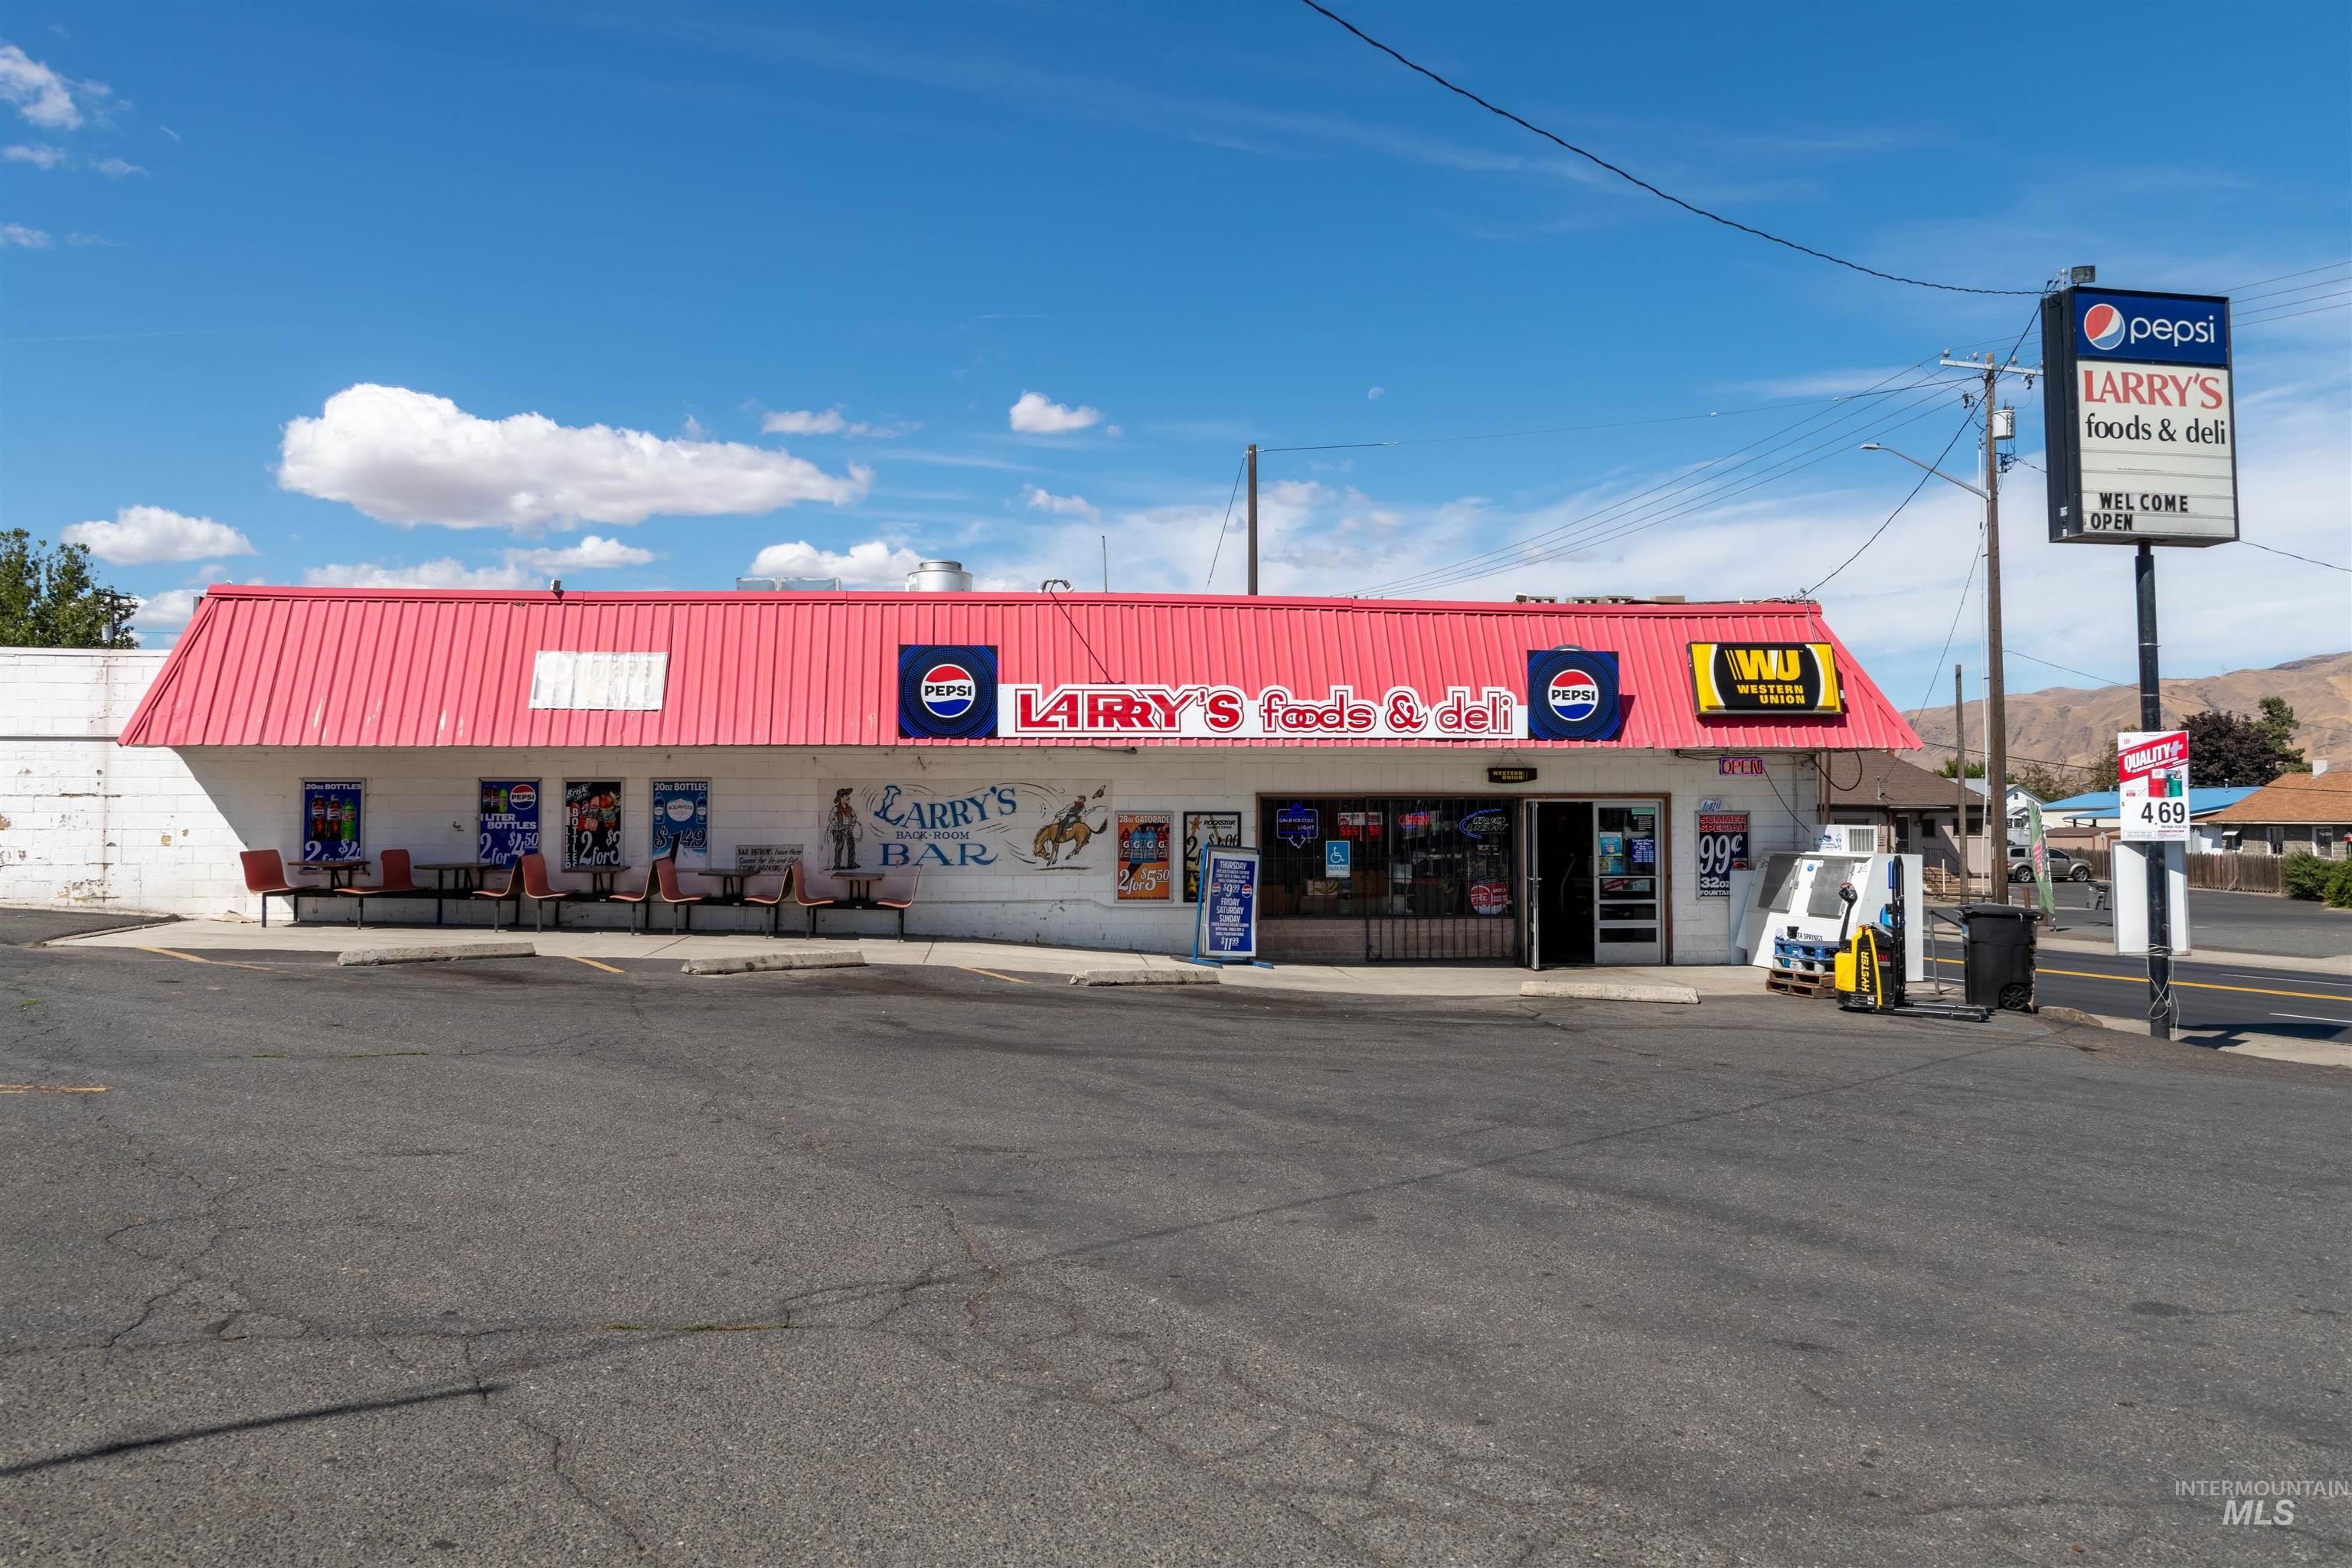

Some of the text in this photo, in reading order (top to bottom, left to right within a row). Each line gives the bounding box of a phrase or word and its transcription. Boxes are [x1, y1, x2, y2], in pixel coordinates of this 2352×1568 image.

[2131, 315, 2215, 347] pepsi
[2083, 370, 2223, 410] LARRY'S
[2086, 413, 2226, 445] foods & deli
[2091, 513, 2133, 531] OPEN
[1725, 649, 1801, 681] WU
[924, 684, 972, 697] PEPSI
[1551, 689, 1596, 701] PEPSI
[1736, 684, 1804, 694] WESTERN
[1759, 694, 1805, 704] UNION
[1015, 688, 1514, 734] LARRY'S foods & deli
[1723, 759, 1762, 774] OPEN
[874, 785, 1017, 829] LARRY'S
[2141, 802, 2185, 825] 4.69
[1700, 815, 1747, 824] SUMMER
[480, 833, 492, 864] 2
[492, 847, 511, 865] for
[580, 828, 621, 866] 2 for $3
[1133, 841, 1140, 849] G
[1147, 841, 1154, 849] G
[1186, 836, 1198, 861] 2
[878, 843, 999, 867] BAR
[1220, 861, 1247, 870] THURSDAY
[1119, 869, 1130, 891] 2
[1127, 877, 1145, 894] for
[1217, 906, 1244, 915] SATURDAY
[1221, 898, 1240, 906] FRIDAY
[1219, 914, 1241, 923] SUNDAY
[1803, 933, 1823, 942] SPRINGS
[1861, 951, 1870, 992] HYSTER
